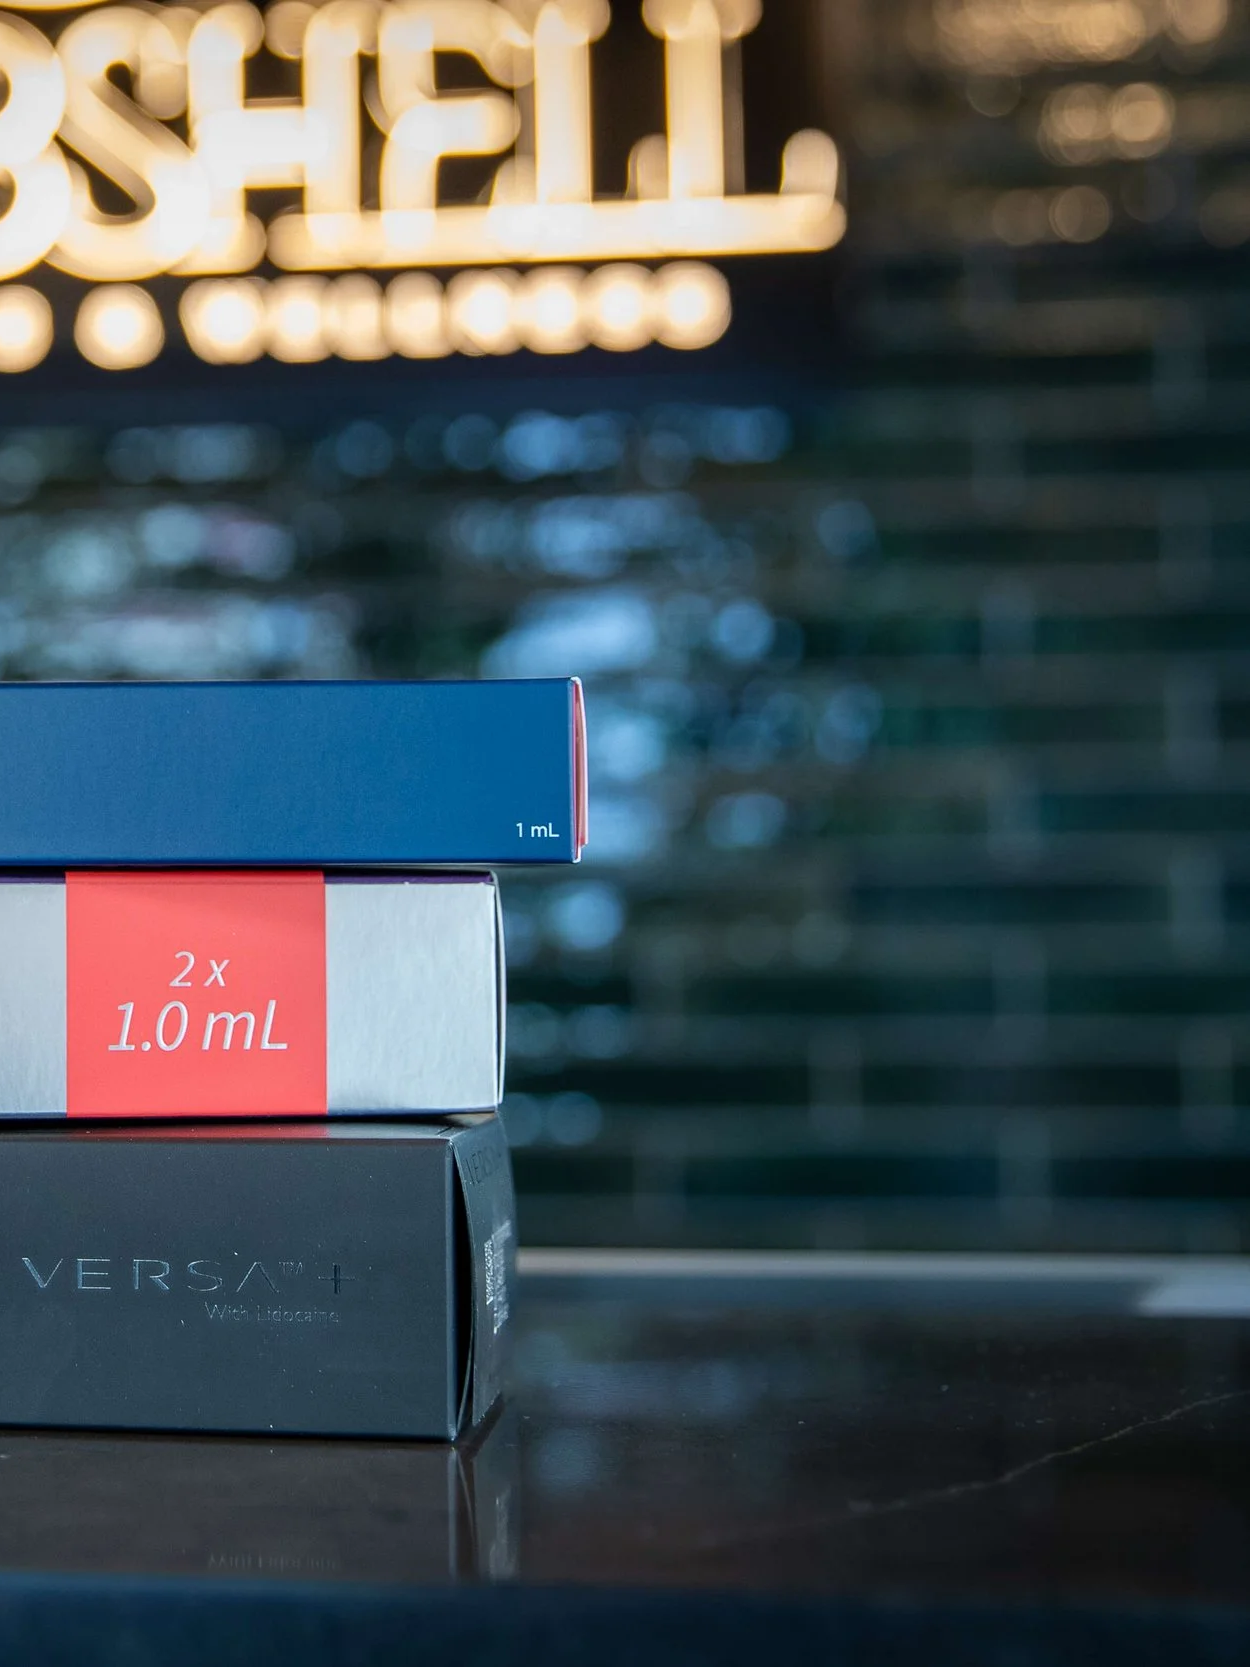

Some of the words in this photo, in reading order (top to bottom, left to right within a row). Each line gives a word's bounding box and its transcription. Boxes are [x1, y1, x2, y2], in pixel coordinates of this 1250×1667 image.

[516, 822, 523, 838] 1
[531, 822, 560, 838] mL
[169, 951, 195, 987] 2
[203, 959, 230, 987] x
[108, 1000, 189, 1052] 1.0
[202, 999, 288, 1051] mL
[204, 1301, 249, 1321] With
[257, 1304, 340, 1323] Lidocaine
